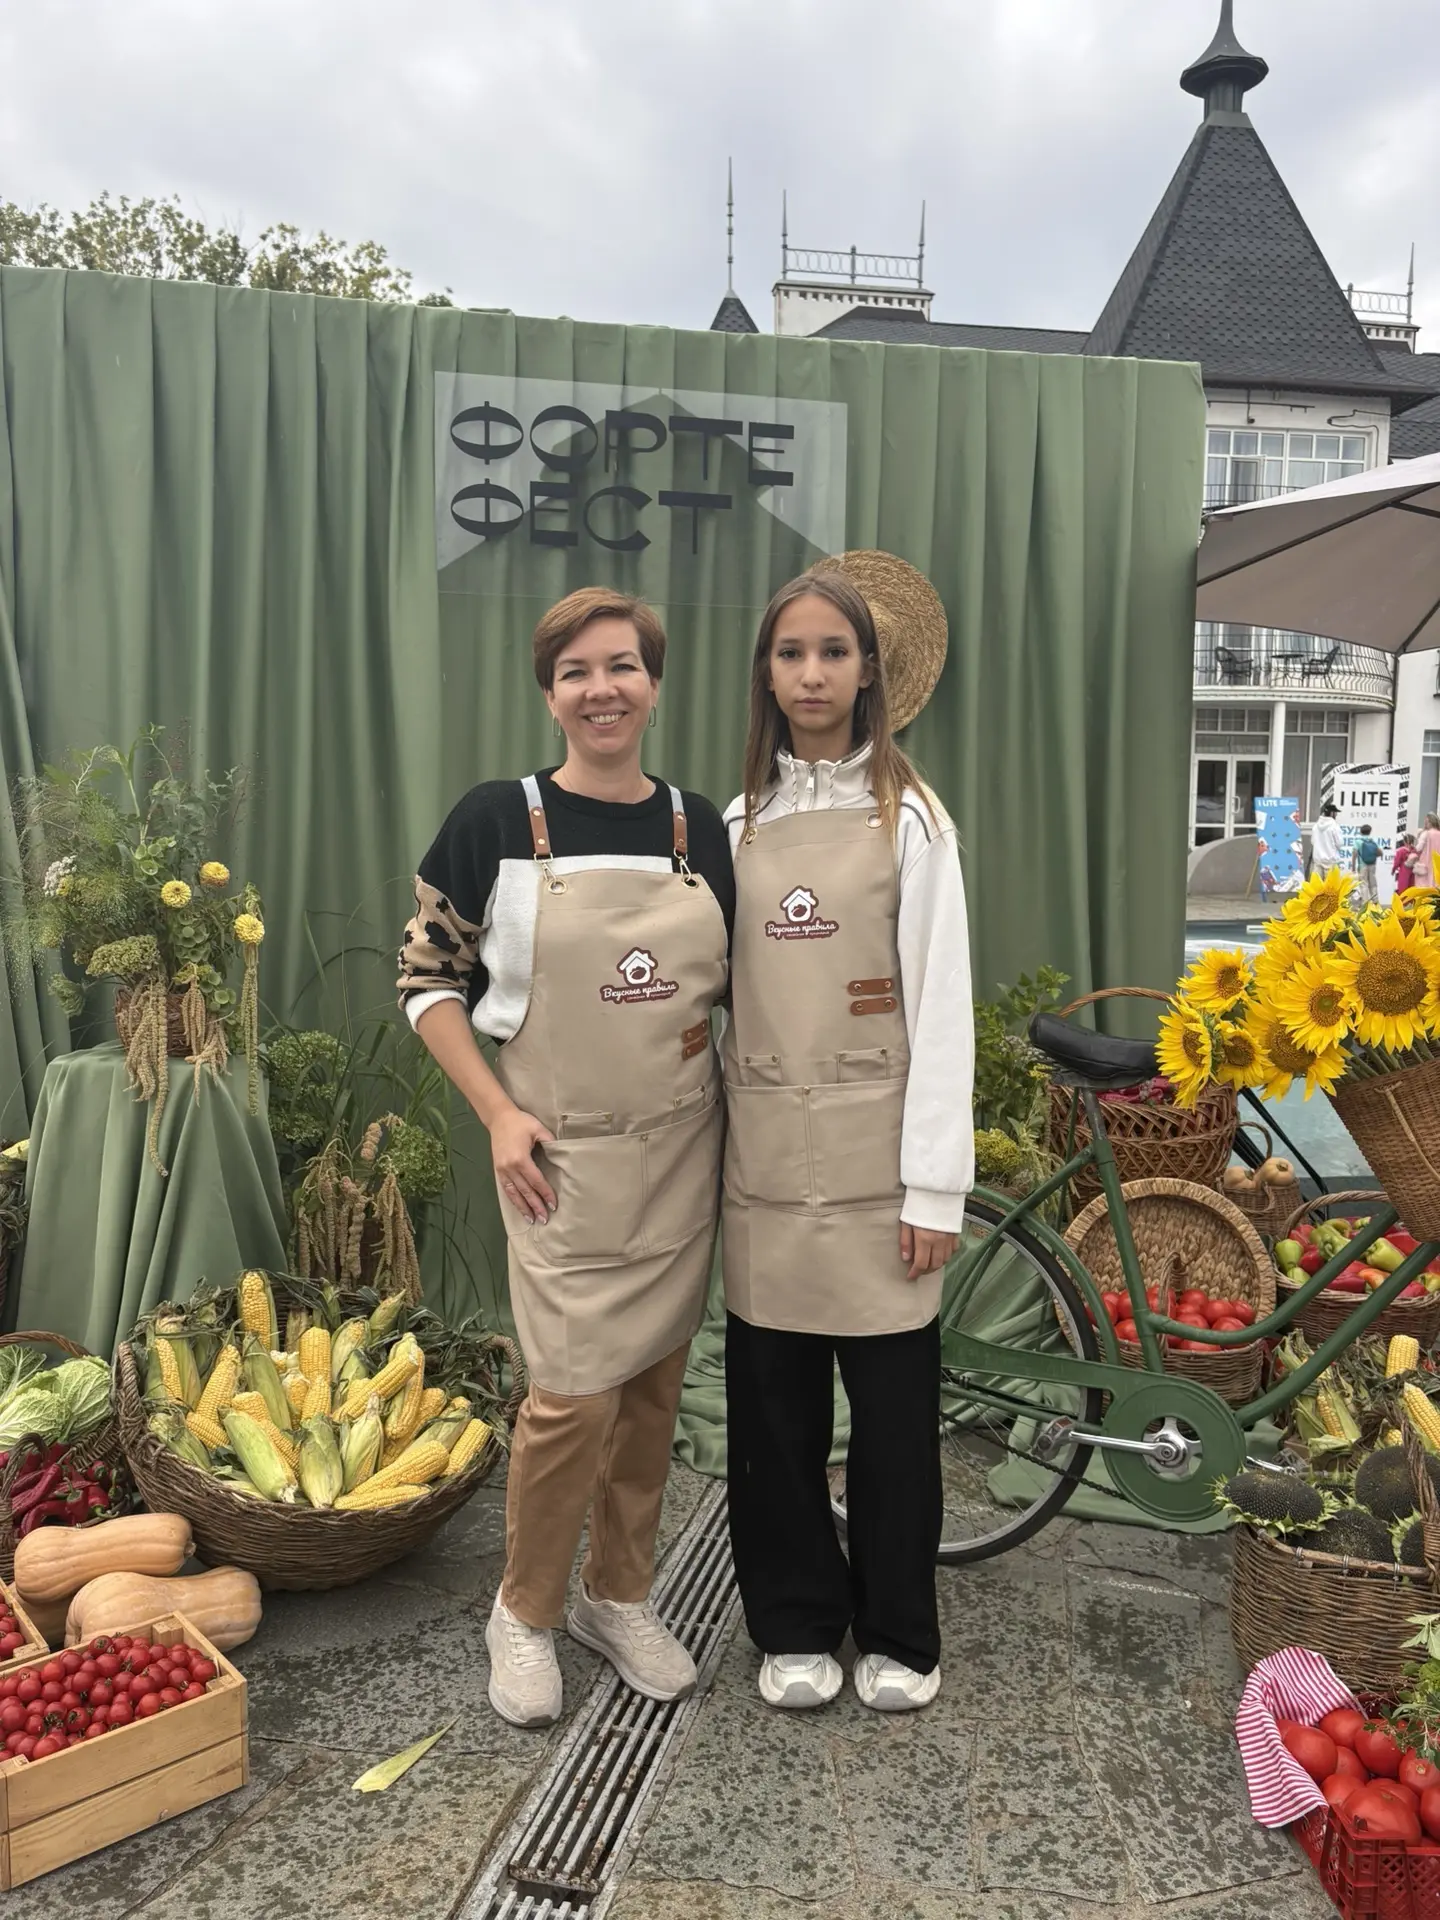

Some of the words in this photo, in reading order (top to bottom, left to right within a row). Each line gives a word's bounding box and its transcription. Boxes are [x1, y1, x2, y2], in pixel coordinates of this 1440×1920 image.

[450, 401, 795, 487] ФОРТЕ
[450, 478, 733, 555] ФЕСТ
[1340, 791, 1345, 807] I
[1351, 791, 1390, 807] LITE
[767, 923, 801, 938] Вкусные
[802, 919, 837, 936] правила
[603, 987, 641, 1001] Вкусные
[642, 981, 677, 998] правила
